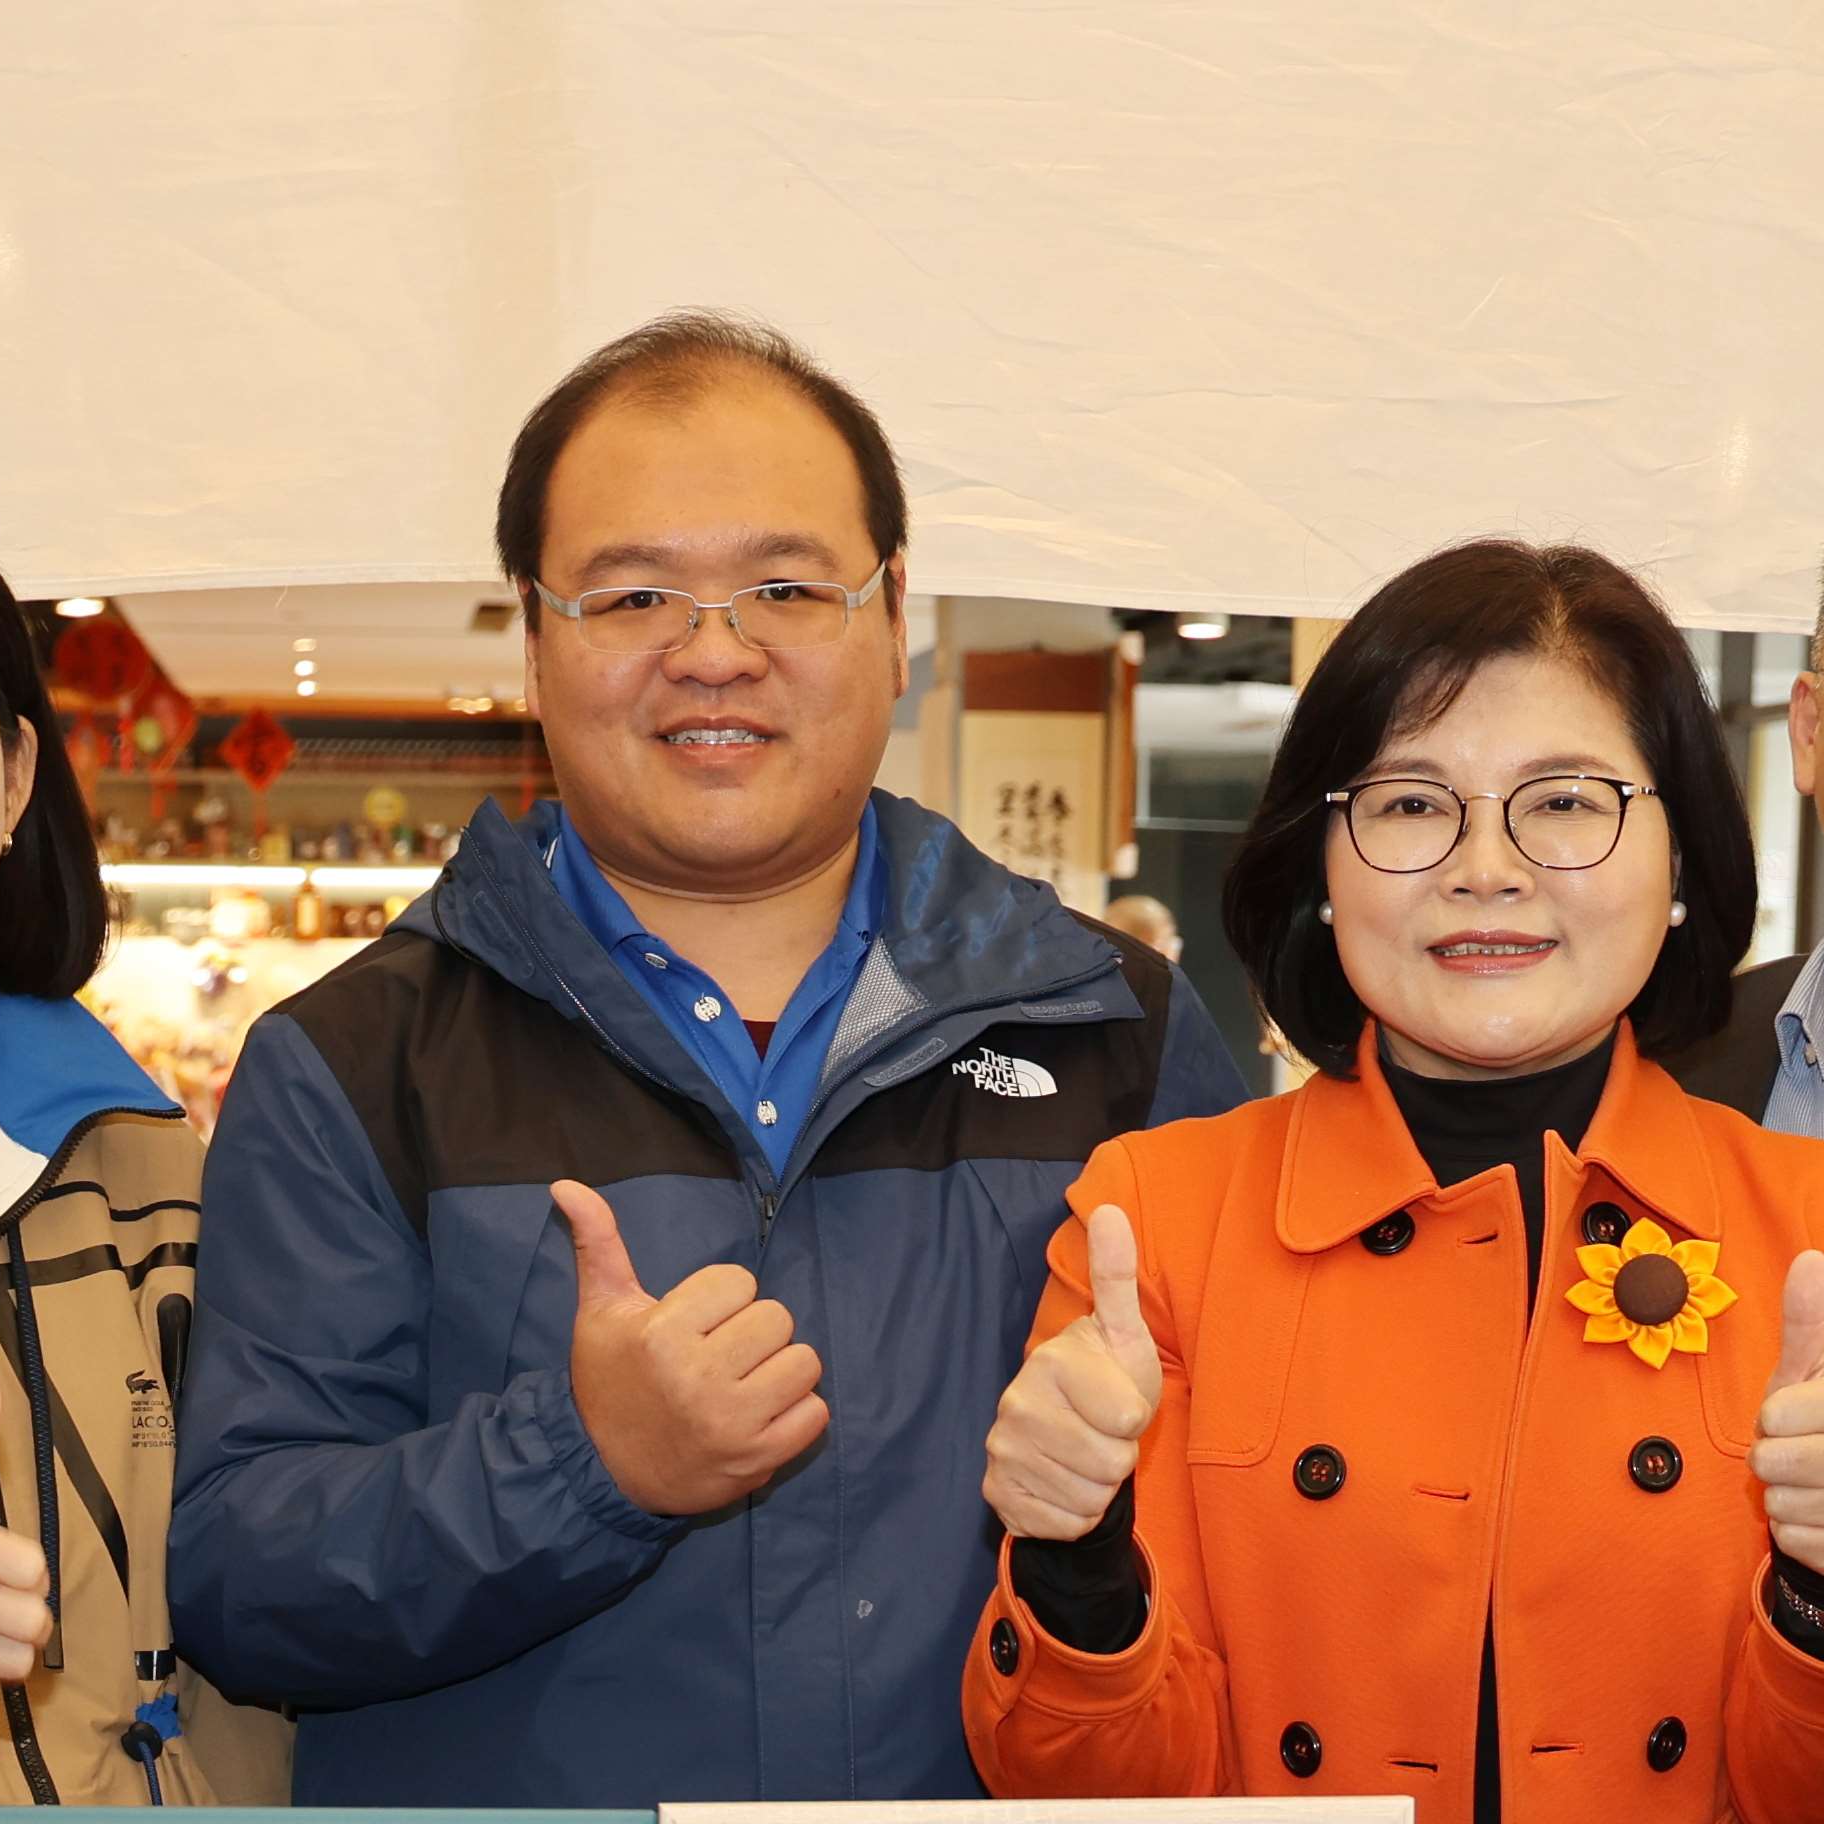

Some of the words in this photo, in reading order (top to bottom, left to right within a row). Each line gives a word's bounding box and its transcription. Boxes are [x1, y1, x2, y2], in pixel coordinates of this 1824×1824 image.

[979, 1047, 1014, 1071] THE
[952, 1059, 1017, 1084] NORTH
[974, 1073, 1021, 1097] FACE
